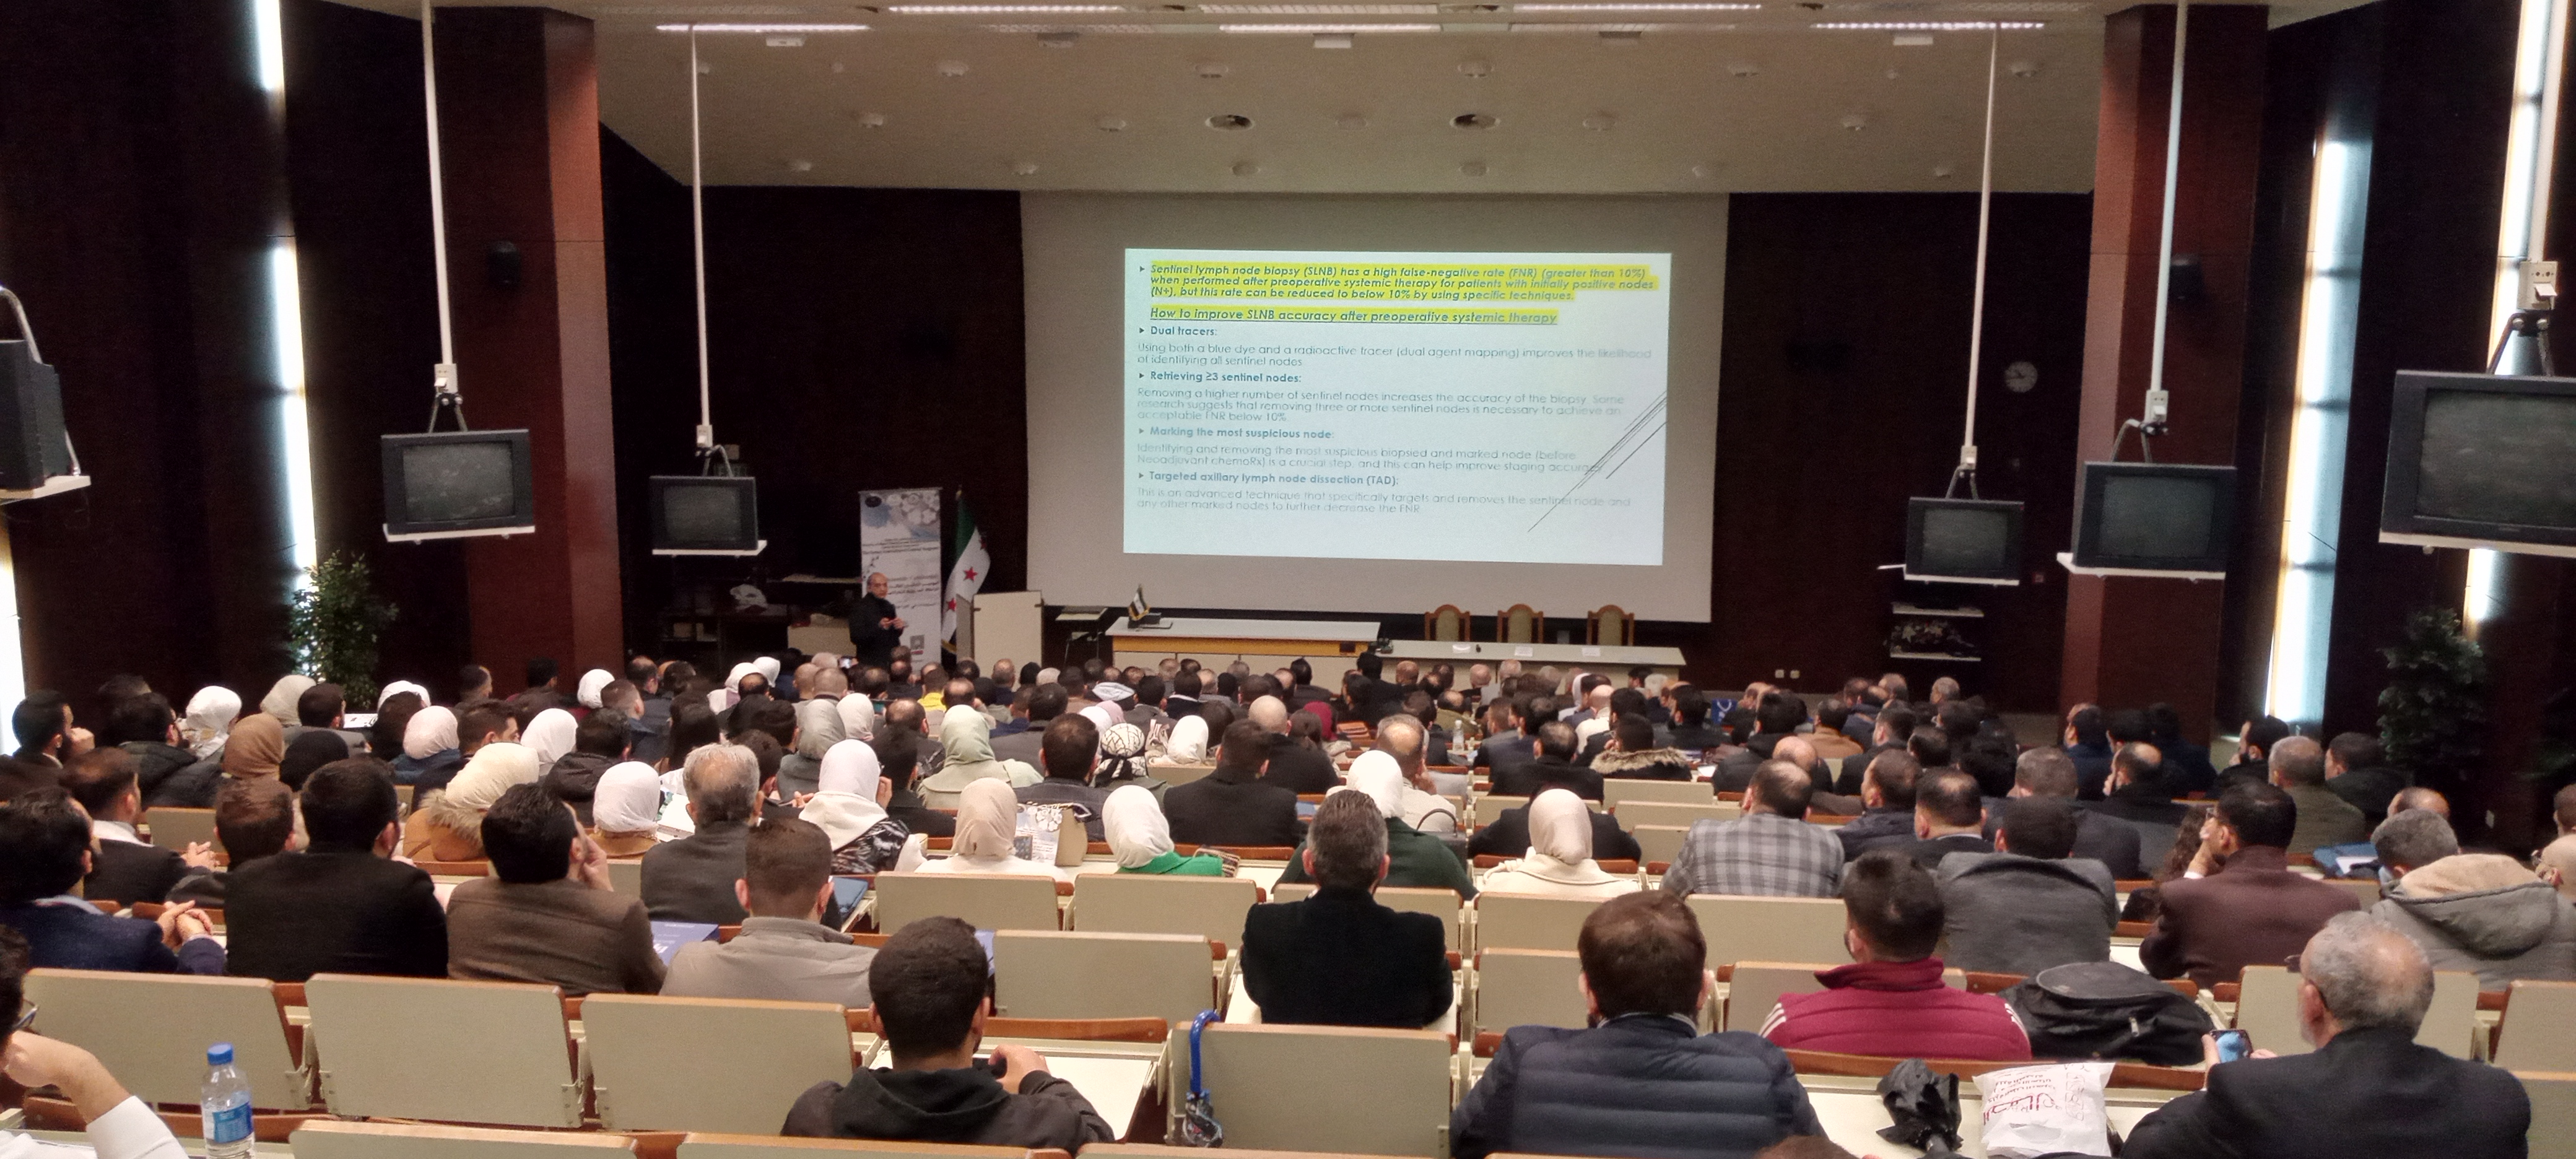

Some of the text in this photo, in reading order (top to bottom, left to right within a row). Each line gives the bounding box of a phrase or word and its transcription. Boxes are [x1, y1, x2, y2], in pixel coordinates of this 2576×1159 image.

[1151, 264, 1193, 274] Sentinel
[1195, 264, 1230, 277] lymph
[1232, 264, 1261, 274] node
[1264, 264, 1301, 277] biopsy
[1303, 265, 1338, 277] (SLNB)
[1341, 265, 1360, 276] has
[1373, 266, 1398, 278] high
[1400, 266, 1481, 279] false-negative
[1483, 266, 1505, 276] rate
[1509, 266, 1538, 279] (FNR)
[1542, 267, 1587, 279] (greater
[1590, 267, 1616, 277] than
[1619, 267, 1646, 280] 10%)
[1150, 275, 1654, 291] when performed after preoperative systemic therapy for patients with initially positive nodes
[1180, 287, 1198, 297] but
[1200, 287, 1219, 297] this
[1221, 287, 1243, 297] rate
[1269, 287, 1286, 297] be
[1287, 287, 1335, 298] reduced
[1338, 288, 1351, 298] to
[1351, 289, 1385, 298] below
[1389, 289, 1411, 299] 10%
[1414, 289, 1428, 302] by
[1431, 289, 1461, 302] using
[1463, 289, 1506, 302] specific
[1509, 290, 1575, 303] techniques.
[1150, 308, 1558, 325] How to improve SLNB accuracy after preoperative systemic therapy
[1151, 325, 1217, 336] Dual tracers:
[1138, 342, 1166, 354] Using
[1168, 343, 1194, 352] both
[1208, 343, 1232, 353] blue
[1234, 344, 1256, 355] dye
[1258, 344, 1281, 354] and
[1294, 344, 1357, 355] radioactive
[1360, 345, 1393, 355] tracer
[1396, 345, 1425, 358] (dual
[1427, 346, 1461, 358] agent
[1464, 347, 1520, 359] mapping)
[1522, 347, 1573, 360] improves
[1577, 348, 1596, 358] the
[1137, 354, 1303, 367] of identifying all sentinel nodes
[1150, 370, 1302, 383] Retrieving ≥3 sentinel nodes:
[1138, 388, 1192, 400] Removing
[1204, 389, 1240, 401] higher
[1242, 389, 1284, 399] number
[1287, 390, 1299, 399] of
[1301, 390, 1342, 400] sentinel
[1344, 391, 1378, 401] nodes
[1382, 391, 1433, 401] increases
[1436, 392, 1453, 401] the
[1456, 395, 1512, 405] accuracy
[1514, 393, 1526, 402] of
[1137, 399, 1185, 409] research
[1186, 399, 1233, 412] suggests
[1236, 400, 1258, 410] that
[1260, 401, 1312, 413] removing
[1315, 401, 1344, 411] three
[1391, 402, 1434, 412] sentinel
[1435, 403, 1470, 413] nodes
[1473, 404, 1480, 413] is
[1482, 406, 1539, 417] necessary
[1541, 405, 1554, 414] to
[1149, 426, 1334, 441] Marking the most suspicious node:
[1137, 443, 1532, 459] Identifying and removing the most suspicious biopsied and marked node
[1149, 471, 1399, 487] Targeted axillary lymph node dissection (TAD):
